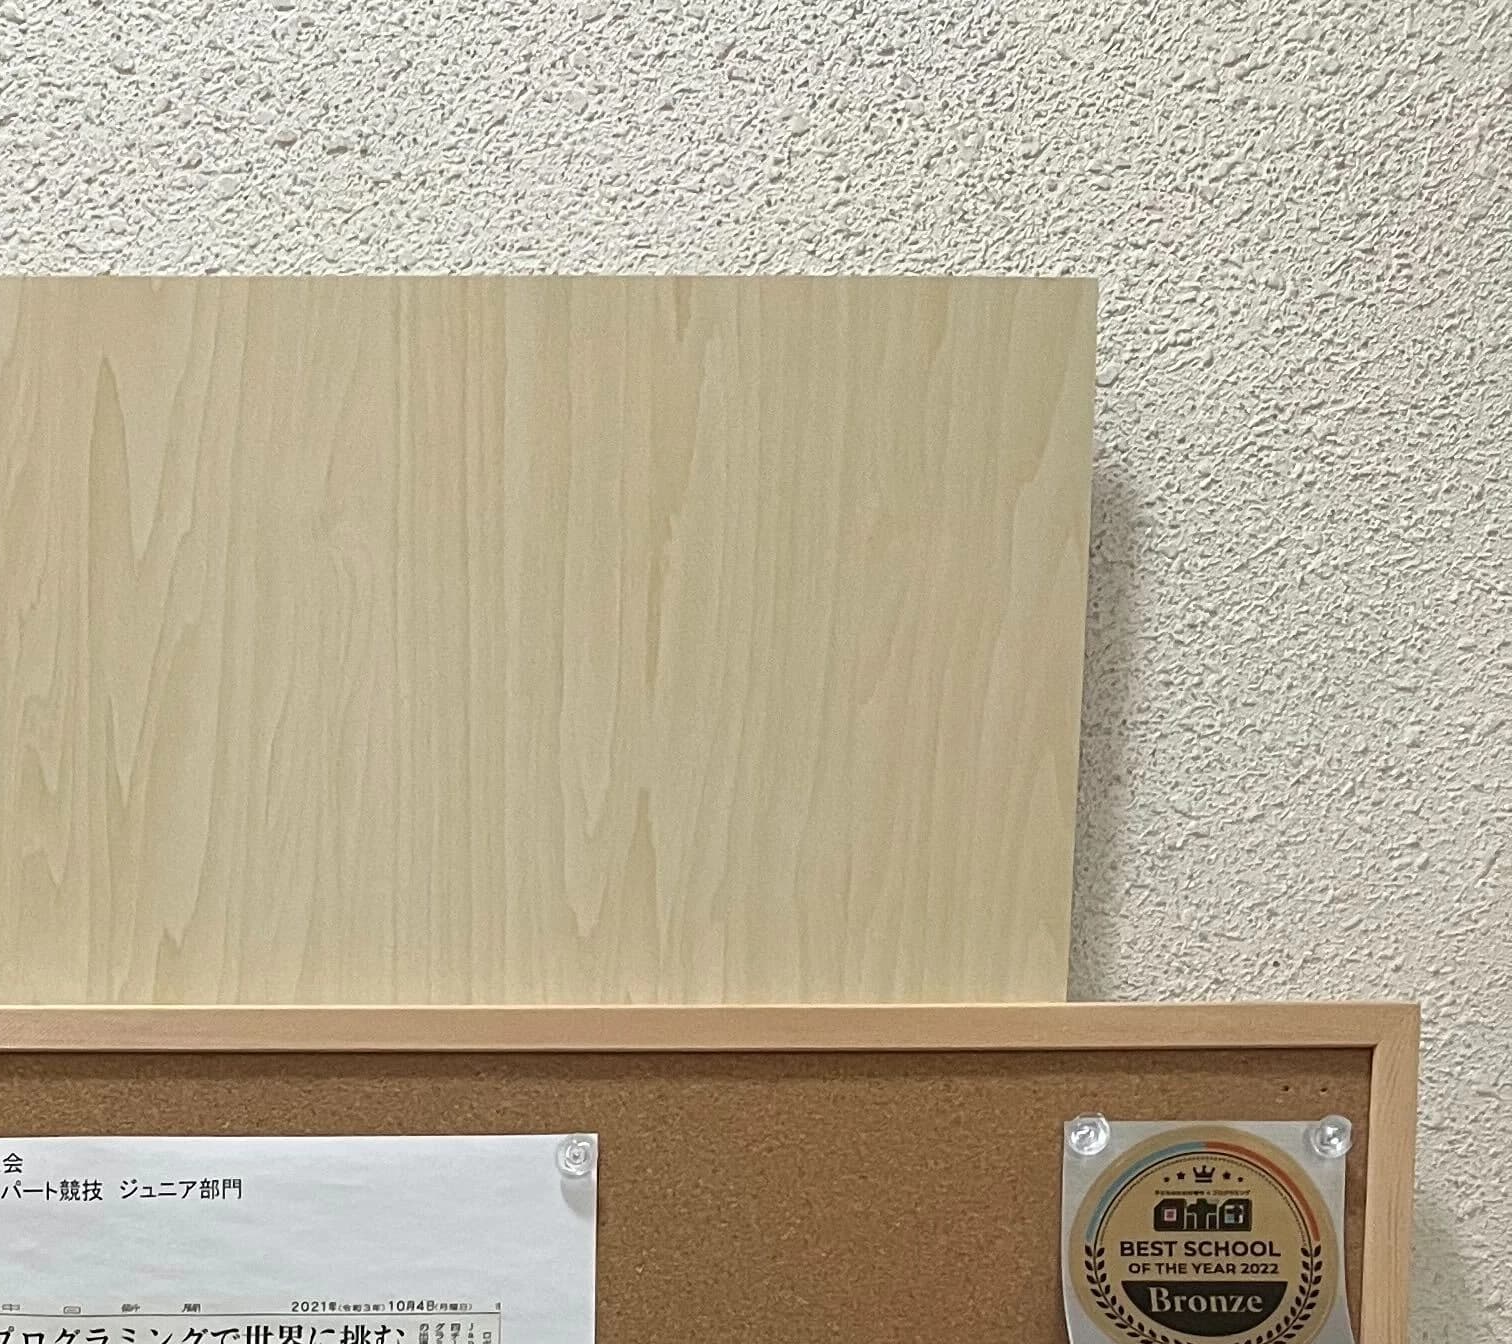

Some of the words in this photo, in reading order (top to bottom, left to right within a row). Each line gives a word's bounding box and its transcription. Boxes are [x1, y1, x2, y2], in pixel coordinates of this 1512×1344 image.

[120, 1178, 243, 1200] ジュニア部門
[1120, 1241, 1177, 1257] BEST
[1184, 1241, 1281, 1257] SCHOOL
[1128, 1263, 1151, 1274] OF
[1157, 1263, 1187, 1274] THE
[1191, 1263, 1236, 1274] YEAR
[1241, 1263, 1280, 1274] 2022
[1150, 1286, 1264, 1313] Bronze
